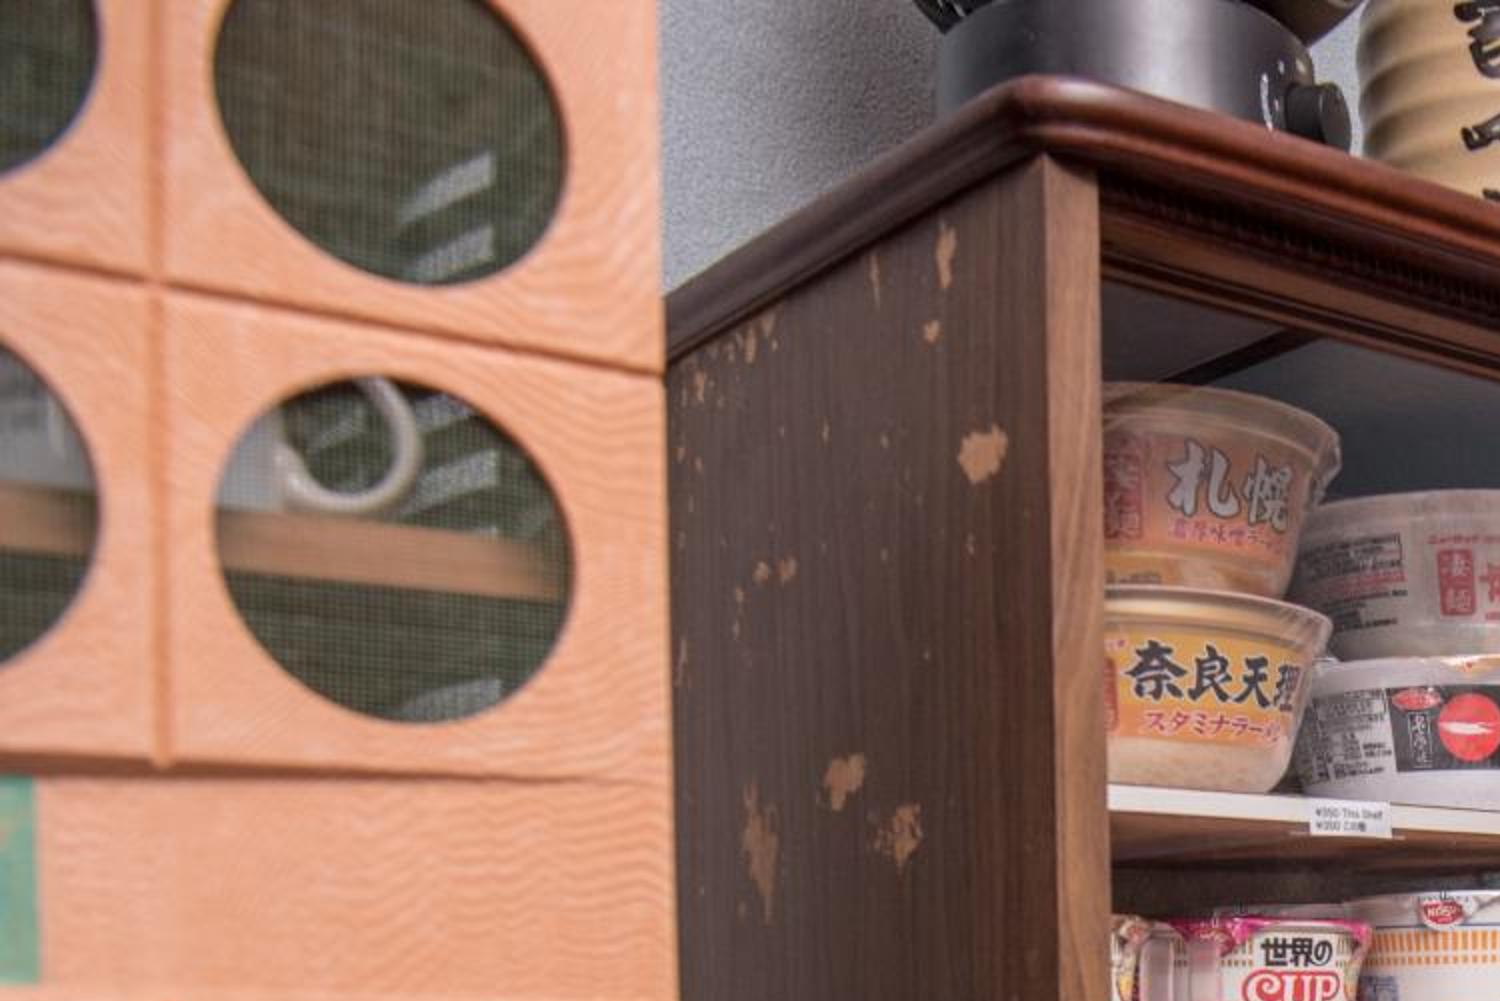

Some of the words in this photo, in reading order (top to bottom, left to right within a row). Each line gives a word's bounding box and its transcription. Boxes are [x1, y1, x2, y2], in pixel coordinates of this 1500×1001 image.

[1166, 434, 1294, 535] 札幌
[1260, 936, 1333, 967] 世界の
